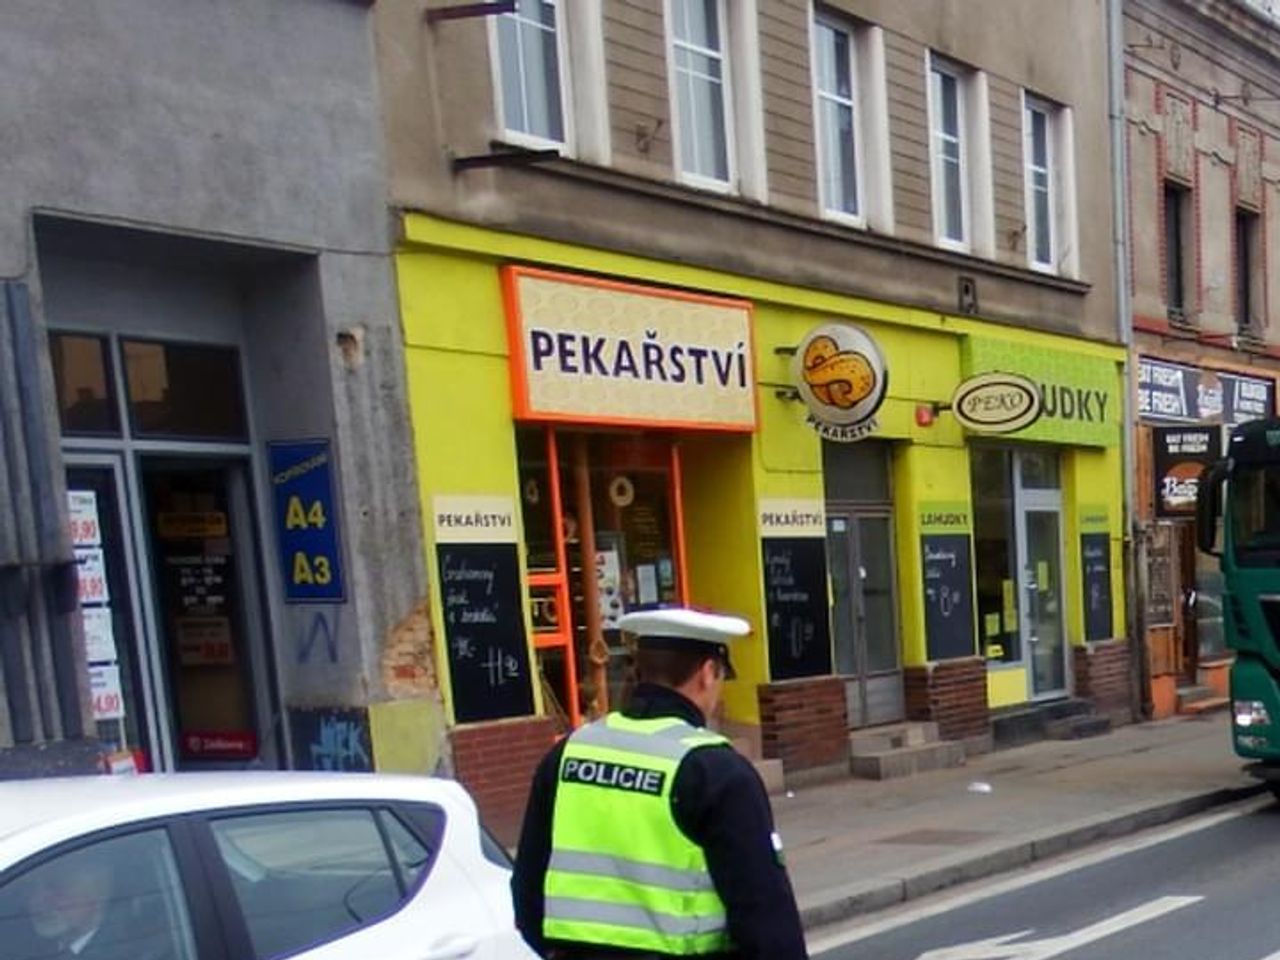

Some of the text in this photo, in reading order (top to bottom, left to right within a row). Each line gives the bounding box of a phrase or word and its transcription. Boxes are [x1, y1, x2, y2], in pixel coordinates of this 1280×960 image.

[530, 329, 747, 388] PEKAŘSTVÍ
[967, 391, 1024, 413] PEKO
[1040, 383, 1108, 423] UDKY
[286, 494, 327, 530] A4
[438, 512, 512, 528] PEKAŘSTVÍ
[293, 551, 331, 585] A3
[564, 759, 662, 792] POLICIE
